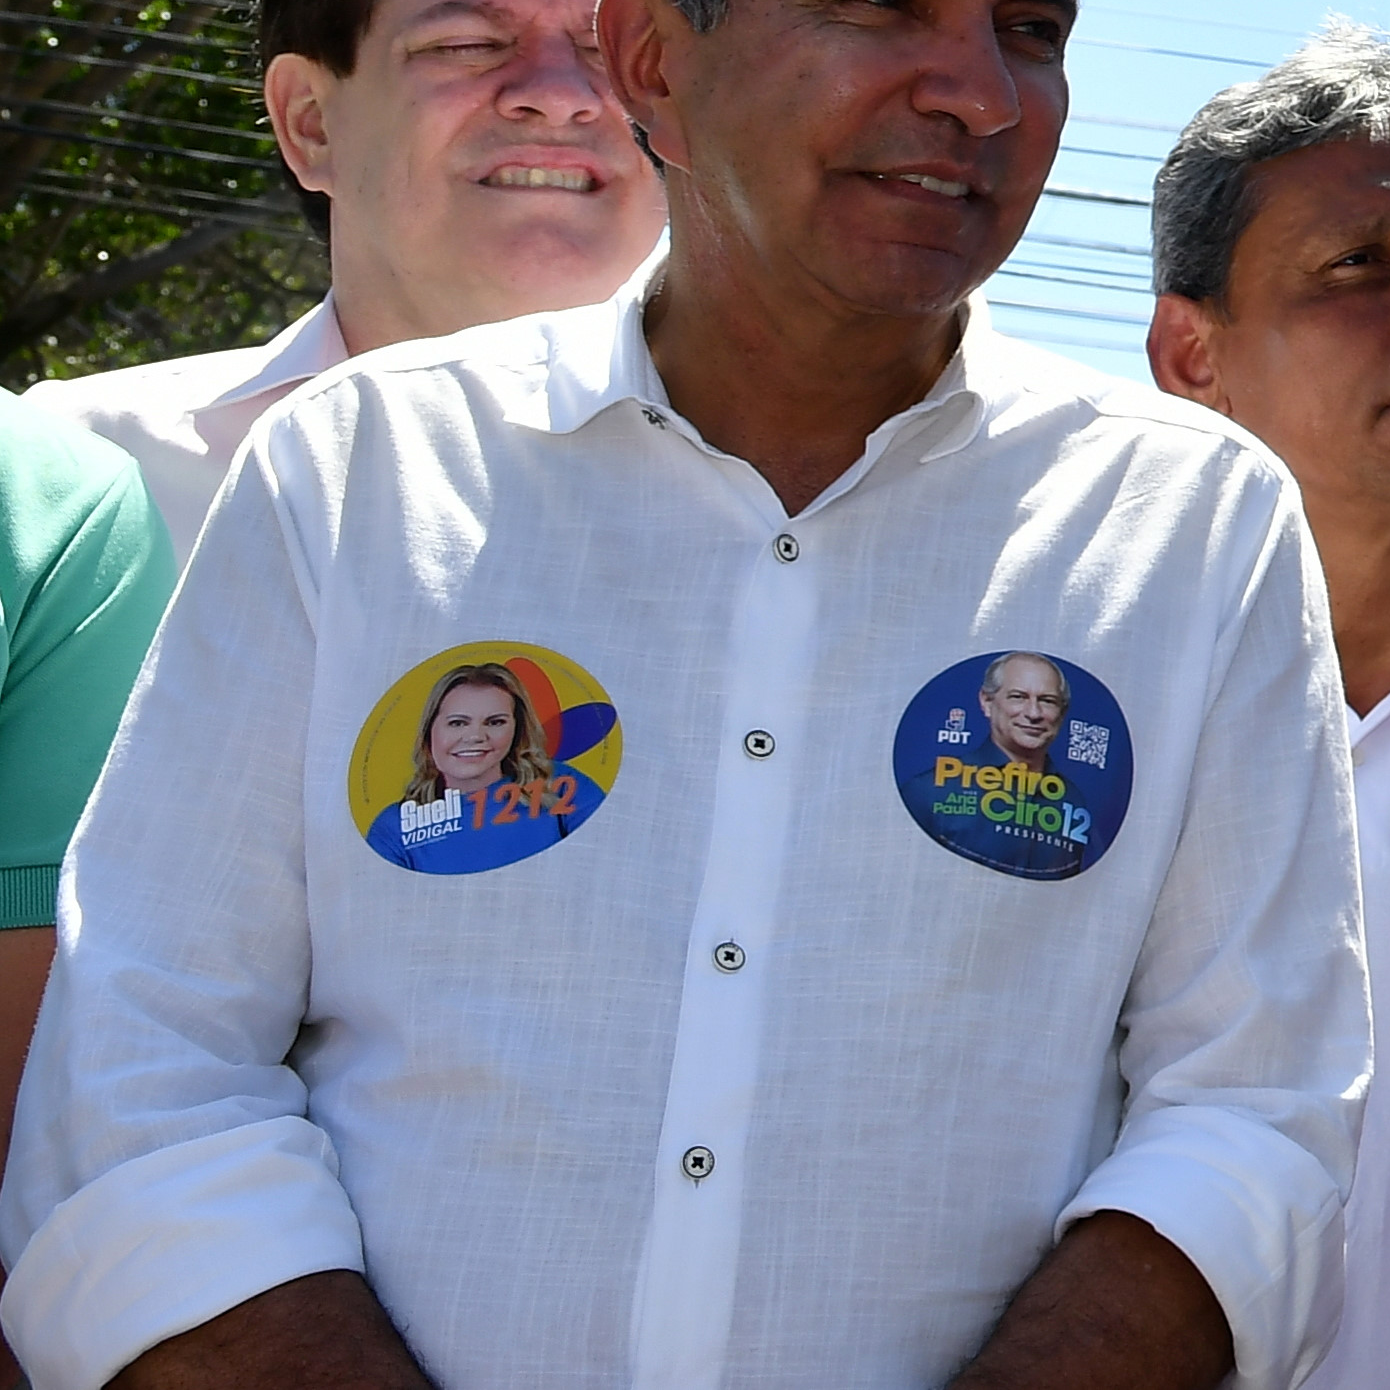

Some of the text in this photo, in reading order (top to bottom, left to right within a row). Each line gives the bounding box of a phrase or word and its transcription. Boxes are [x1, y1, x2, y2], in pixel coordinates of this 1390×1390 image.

[937, 729, 972, 745] PDT
[934, 756, 1066, 800] Prefiro
[400, 788, 463, 833] Sueli
[467, 775, 578, 830] 1212
[933, 802, 977, 815] Paula
[945, 792, 977, 804] Ana
[980, 790, 1092, 845] Ciro 12
[401, 819, 463, 846] VIDIGAL
[995, 825, 1075, 852] PRESIDENTE
